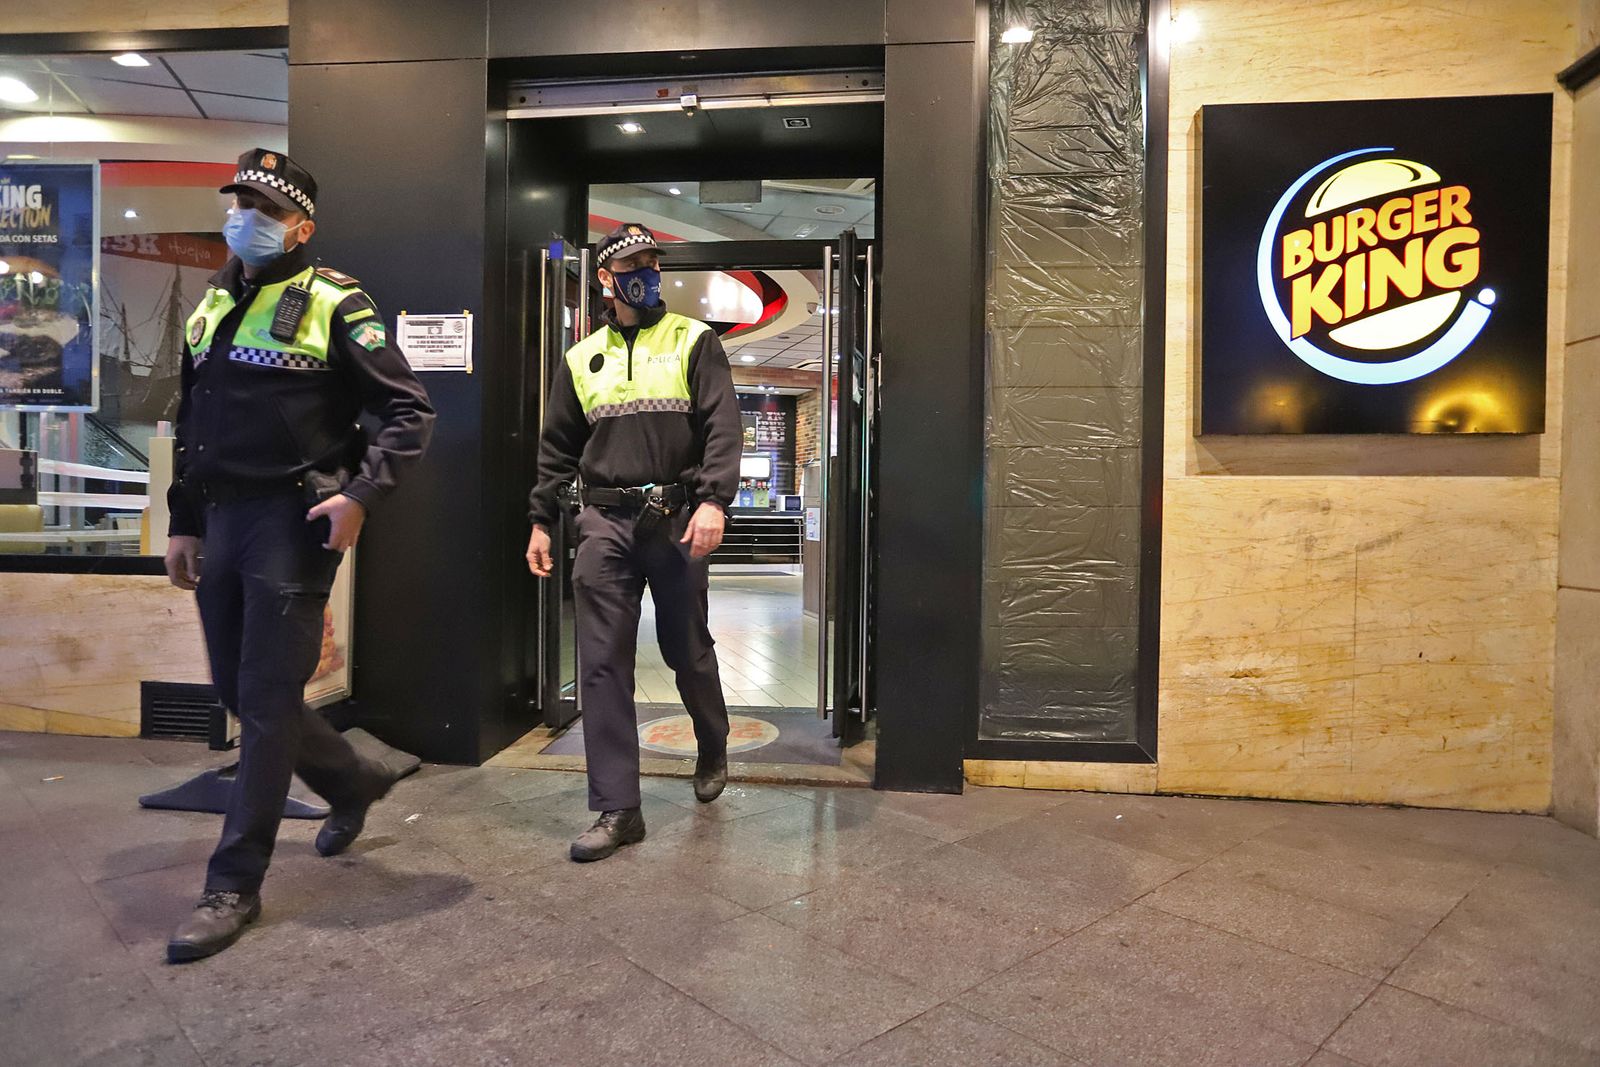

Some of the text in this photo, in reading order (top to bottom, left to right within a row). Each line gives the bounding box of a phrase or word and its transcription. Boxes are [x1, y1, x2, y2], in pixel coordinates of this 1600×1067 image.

[0, 185, 42, 208] ING
[12, 235, 31, 243] CON
[33, 235, 58, 243] SETAS
[1282, 185, 1473, 280] BURGER
[1290, 226, 1481, 342] KING
[647, 354, 680, 364] POLICA
